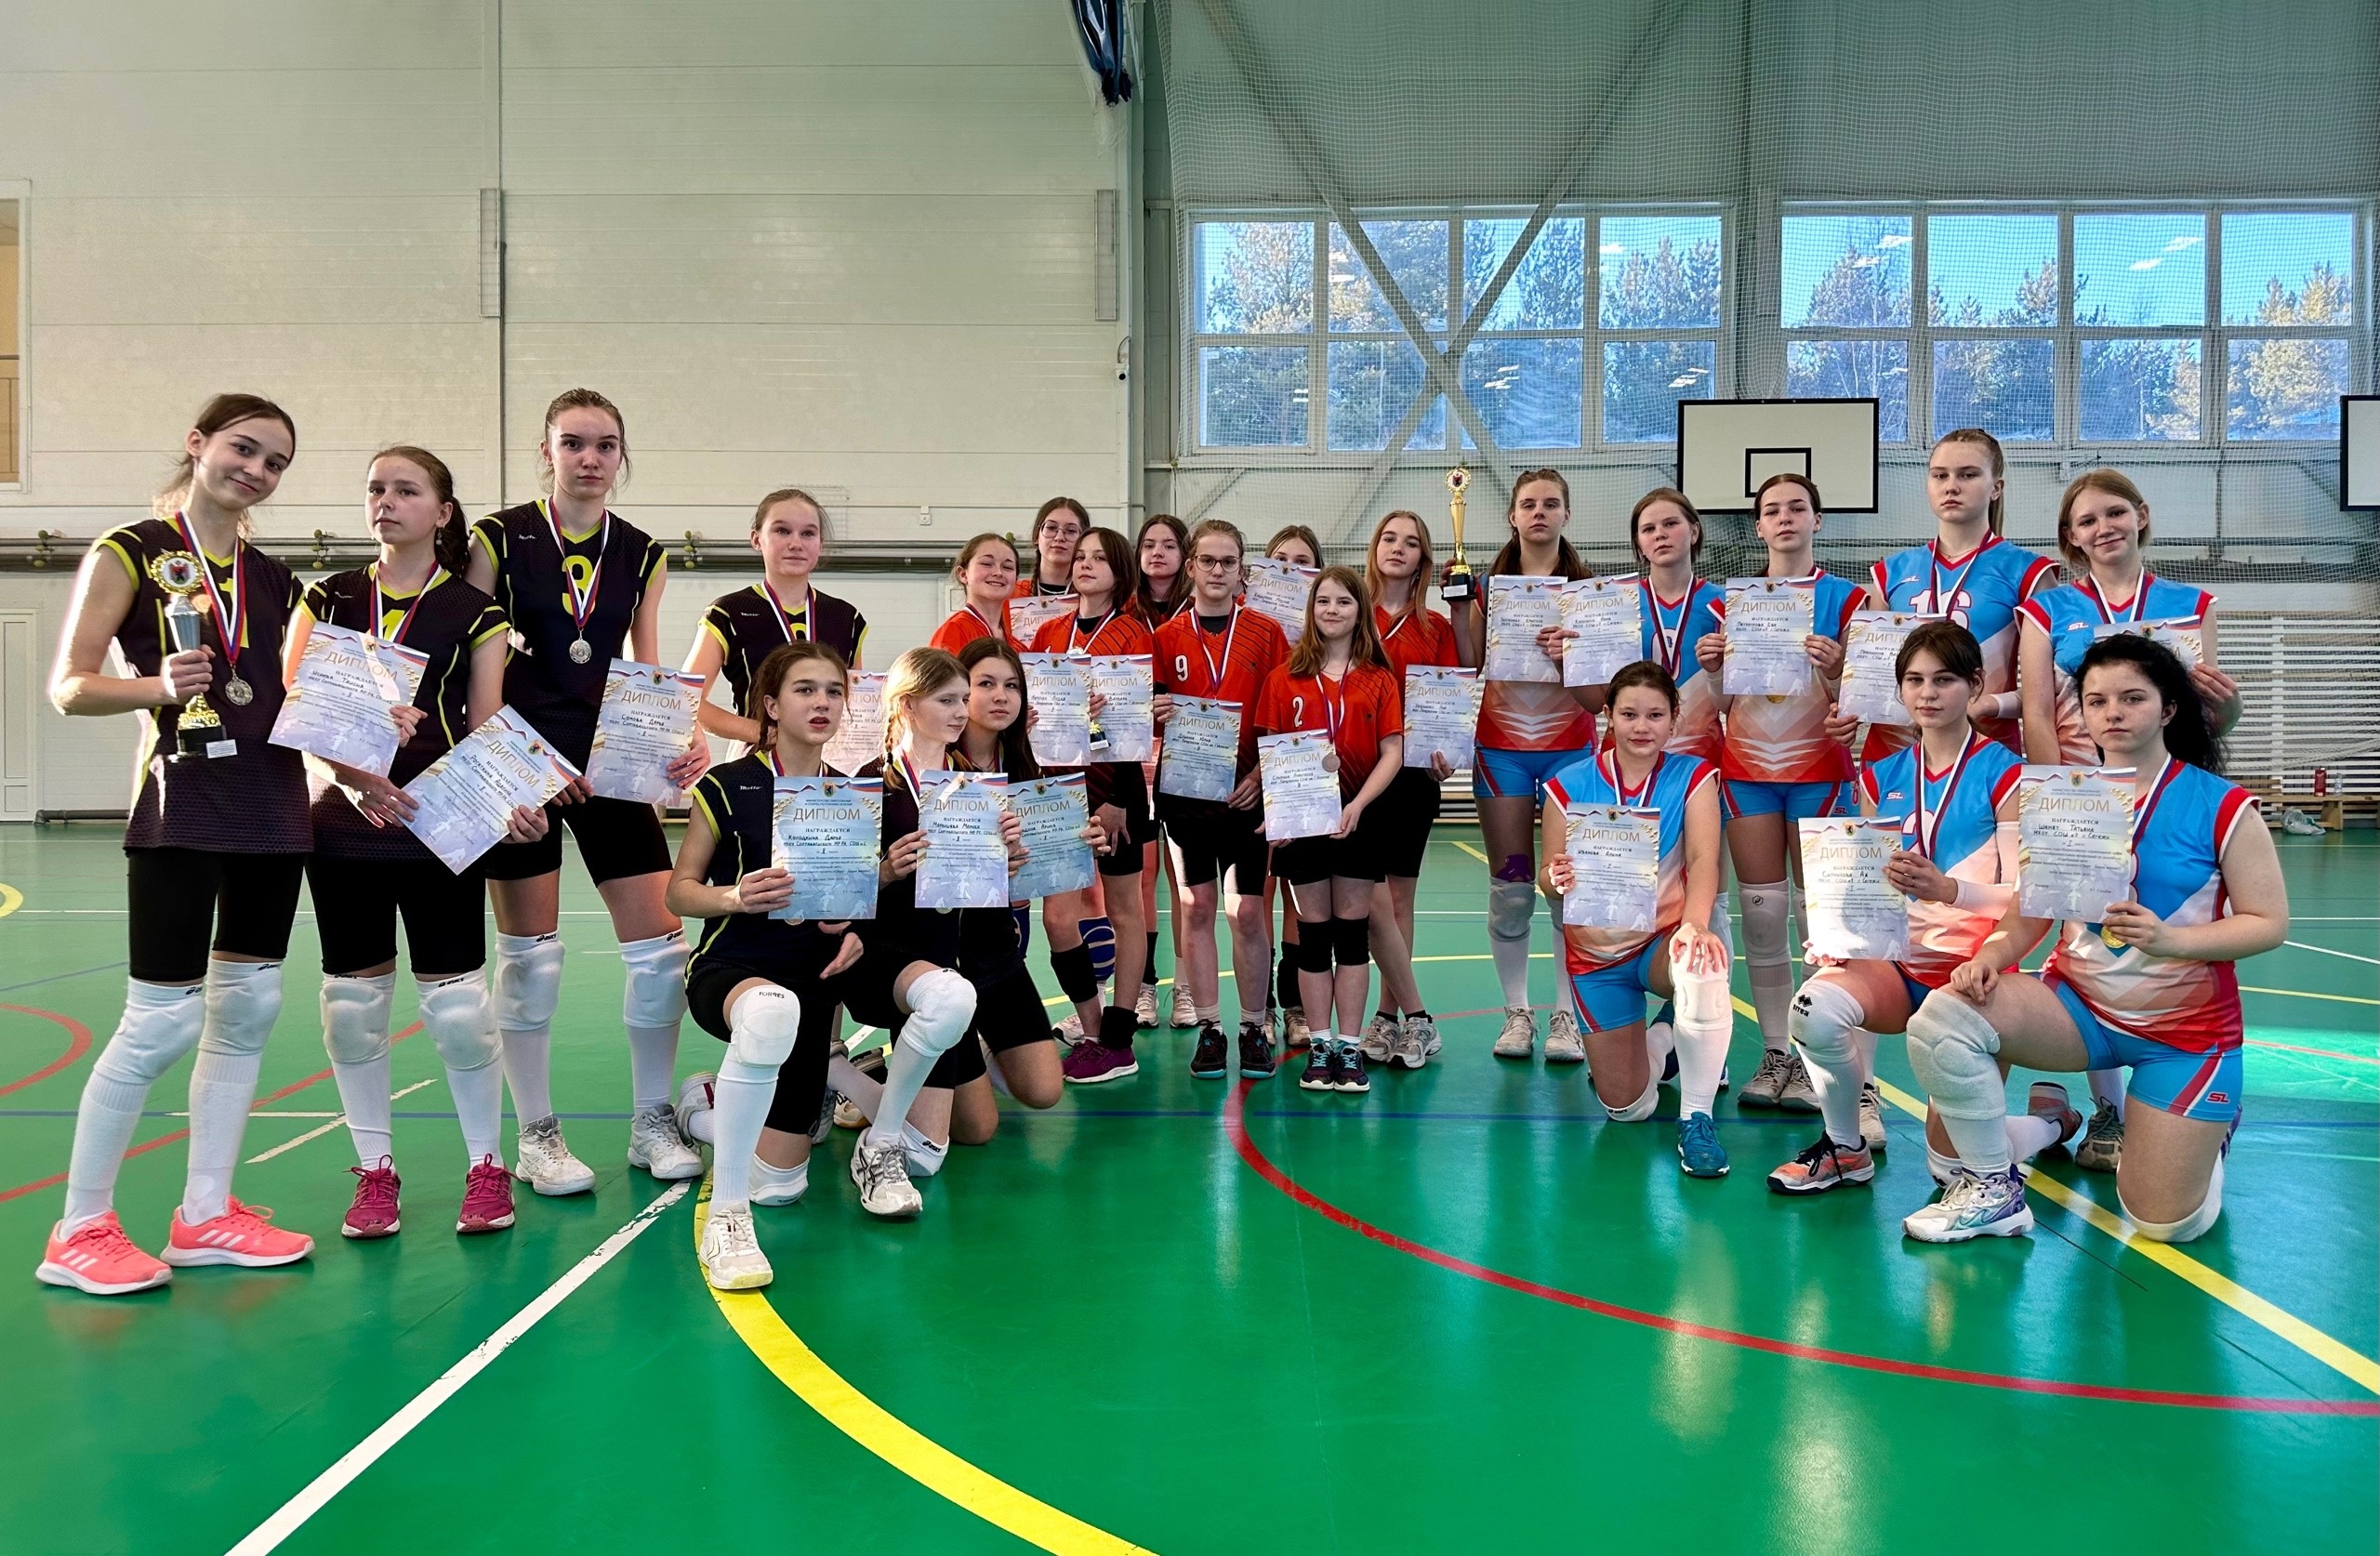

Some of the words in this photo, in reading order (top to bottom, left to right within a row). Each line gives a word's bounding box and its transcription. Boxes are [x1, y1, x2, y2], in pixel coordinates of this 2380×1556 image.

[1260, 578, 1302, 593] ДИПЛОМ
[1506, 601, 1550, 610] ДИПЛОМ
[1574, 597, 1624, 612] ДИПЛОМ
[1741, 602, 1796, 613] ДИПЛОМ
[1909, 589, 1972, 630] 16
[2067, 622, 2089, 631] SL
[1865, 632, 1906, 643] ДИПЛО
[324, 652, 397, 680] ДИПЛОМ
[1175, 654, 1189, 682] 9
[1032, 677, 1076, 687] ДИПЛОМ
[1092, 678, 1137, 687] ДИПЛОМ
[1417, 687, 1461, 697] ДИПЛОМ
[621, 690, 681, 710] ДИПЛОМ
[631, 710, 671, 720] НАГРАЖДАЕТСЯ
[1293, 696, 1304, 727] 2
[1178, 716, 1225, 731] ДИПЛОМ
[485, 740, 540, 788] ДИПЛОМ
[1274, 752, 1321, 767] ДИПЛОМ
[1886, 792, 1904, 800] SL
[934, 799, 989, 812] ДИПЛОМ
[1015, 800, 1071, 818] ДИПЛОМ
[2039, 798, 2109, 812] ДИПЛОМ
[793, 808, 860, 822] ДИПЛОМ
[1027, 817, 1064, 825] НАГРАЖДАЕТСЯ
[1582, 828, 1640, 842] ДИПЛОМ
[1820, 847, 1882, 860] ДИПЛОМ
[2205, 1091, 2230, 1104] SL
